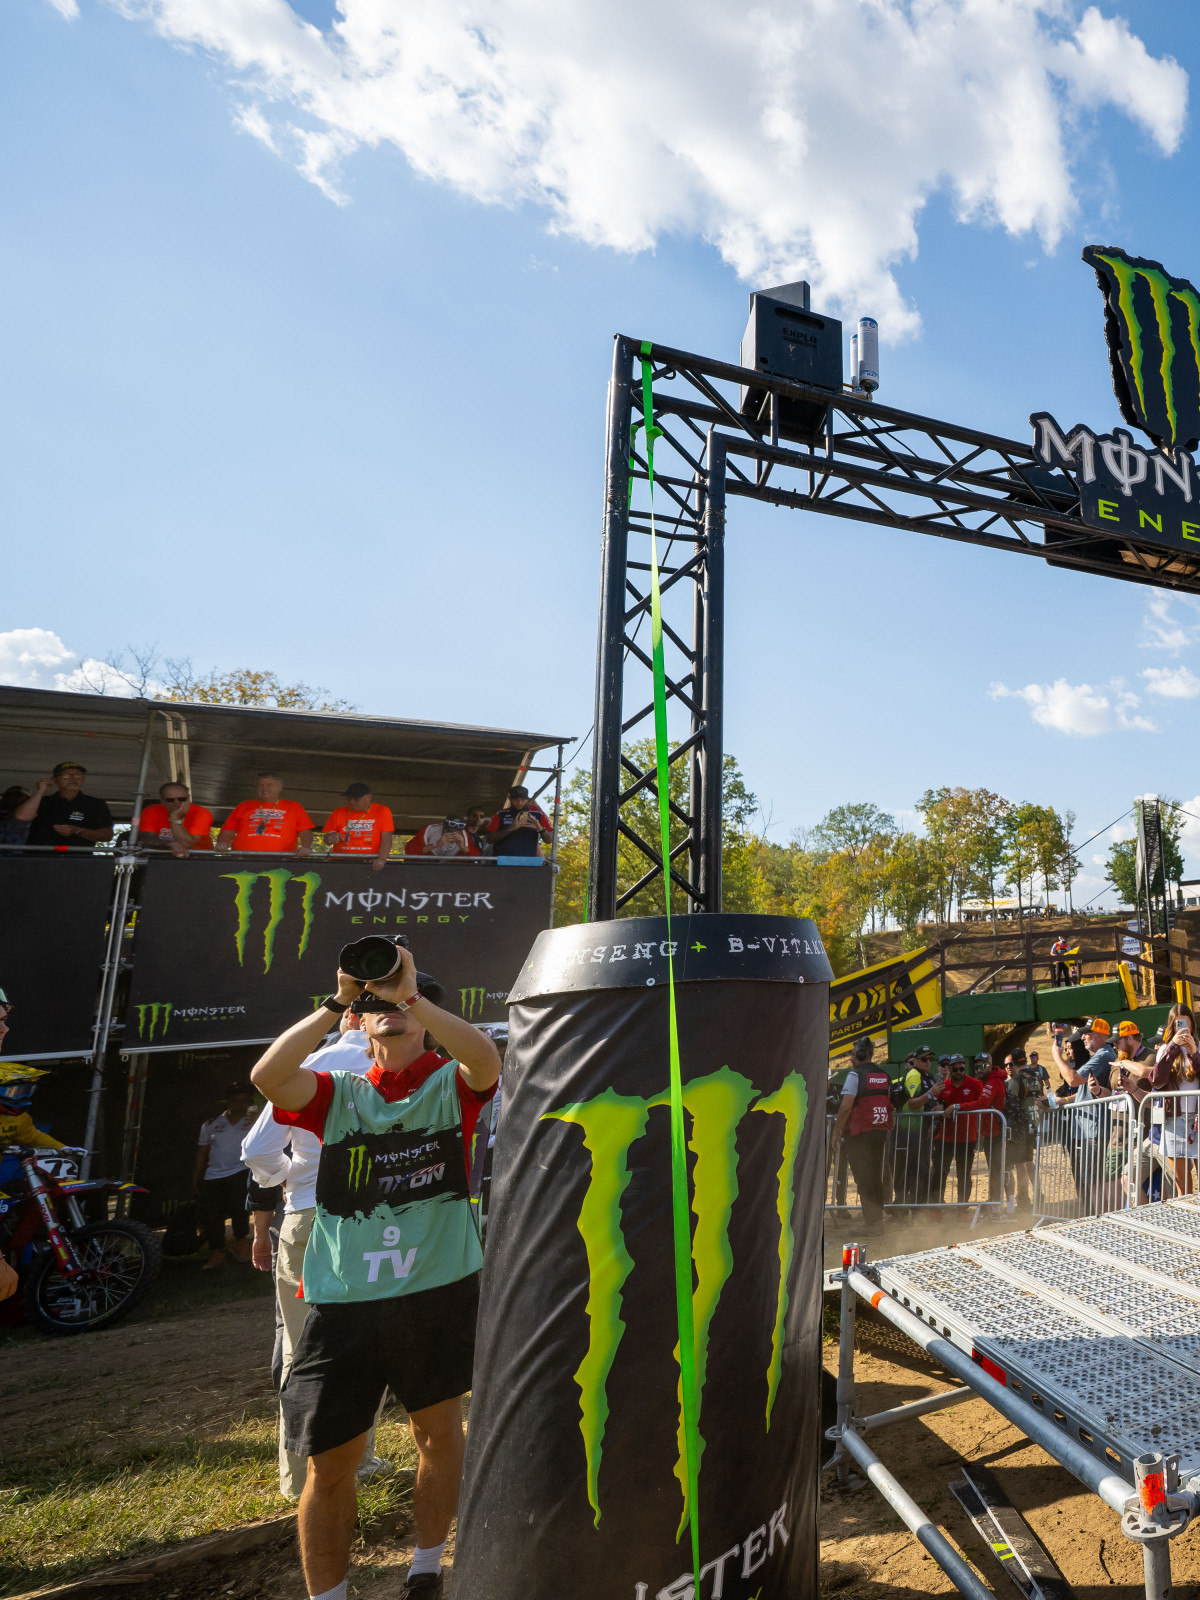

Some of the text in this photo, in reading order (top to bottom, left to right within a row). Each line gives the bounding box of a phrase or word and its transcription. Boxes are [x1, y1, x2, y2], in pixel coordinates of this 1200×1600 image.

[325, 888, 494, 912] MONSTER
[351, 915, 469, 924] ENERGY
[174, 1006, 245, 1017] MONSTER
[831, 1022, 862, 1037] PARTS
[374, 1140, 440, 1163] MONSTER
[382, 1226, 400, 1247] 9
[362, 1248, 418, 1283] TV
